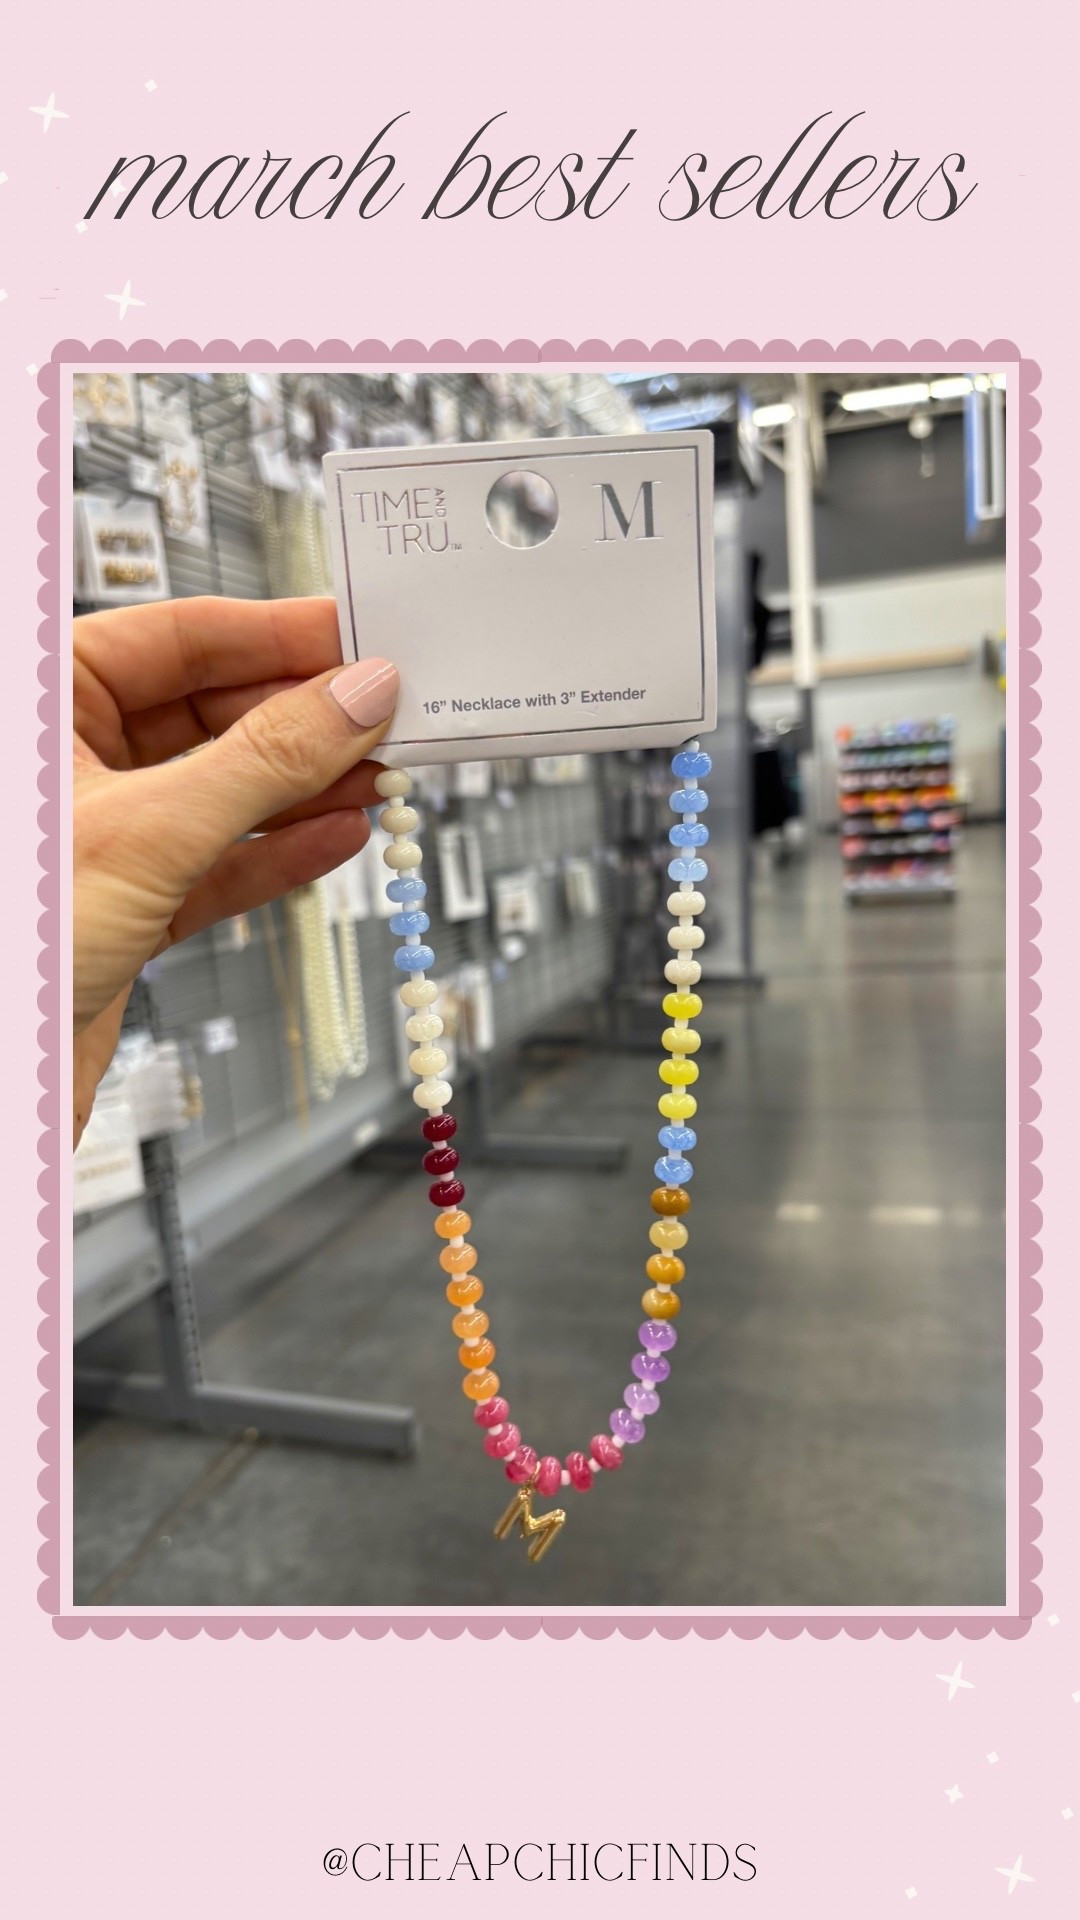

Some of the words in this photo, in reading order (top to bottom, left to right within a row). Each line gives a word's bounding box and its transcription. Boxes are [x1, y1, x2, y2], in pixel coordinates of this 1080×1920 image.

[351, 487, 433, 522] TIME
[434, 487, 447, 518] AND
[592, 480, 663, 542] M
[452, 697, 521, 712] Necklace
[525, 693, 556, 708] with
[581, 688, 646, 704] Extender
